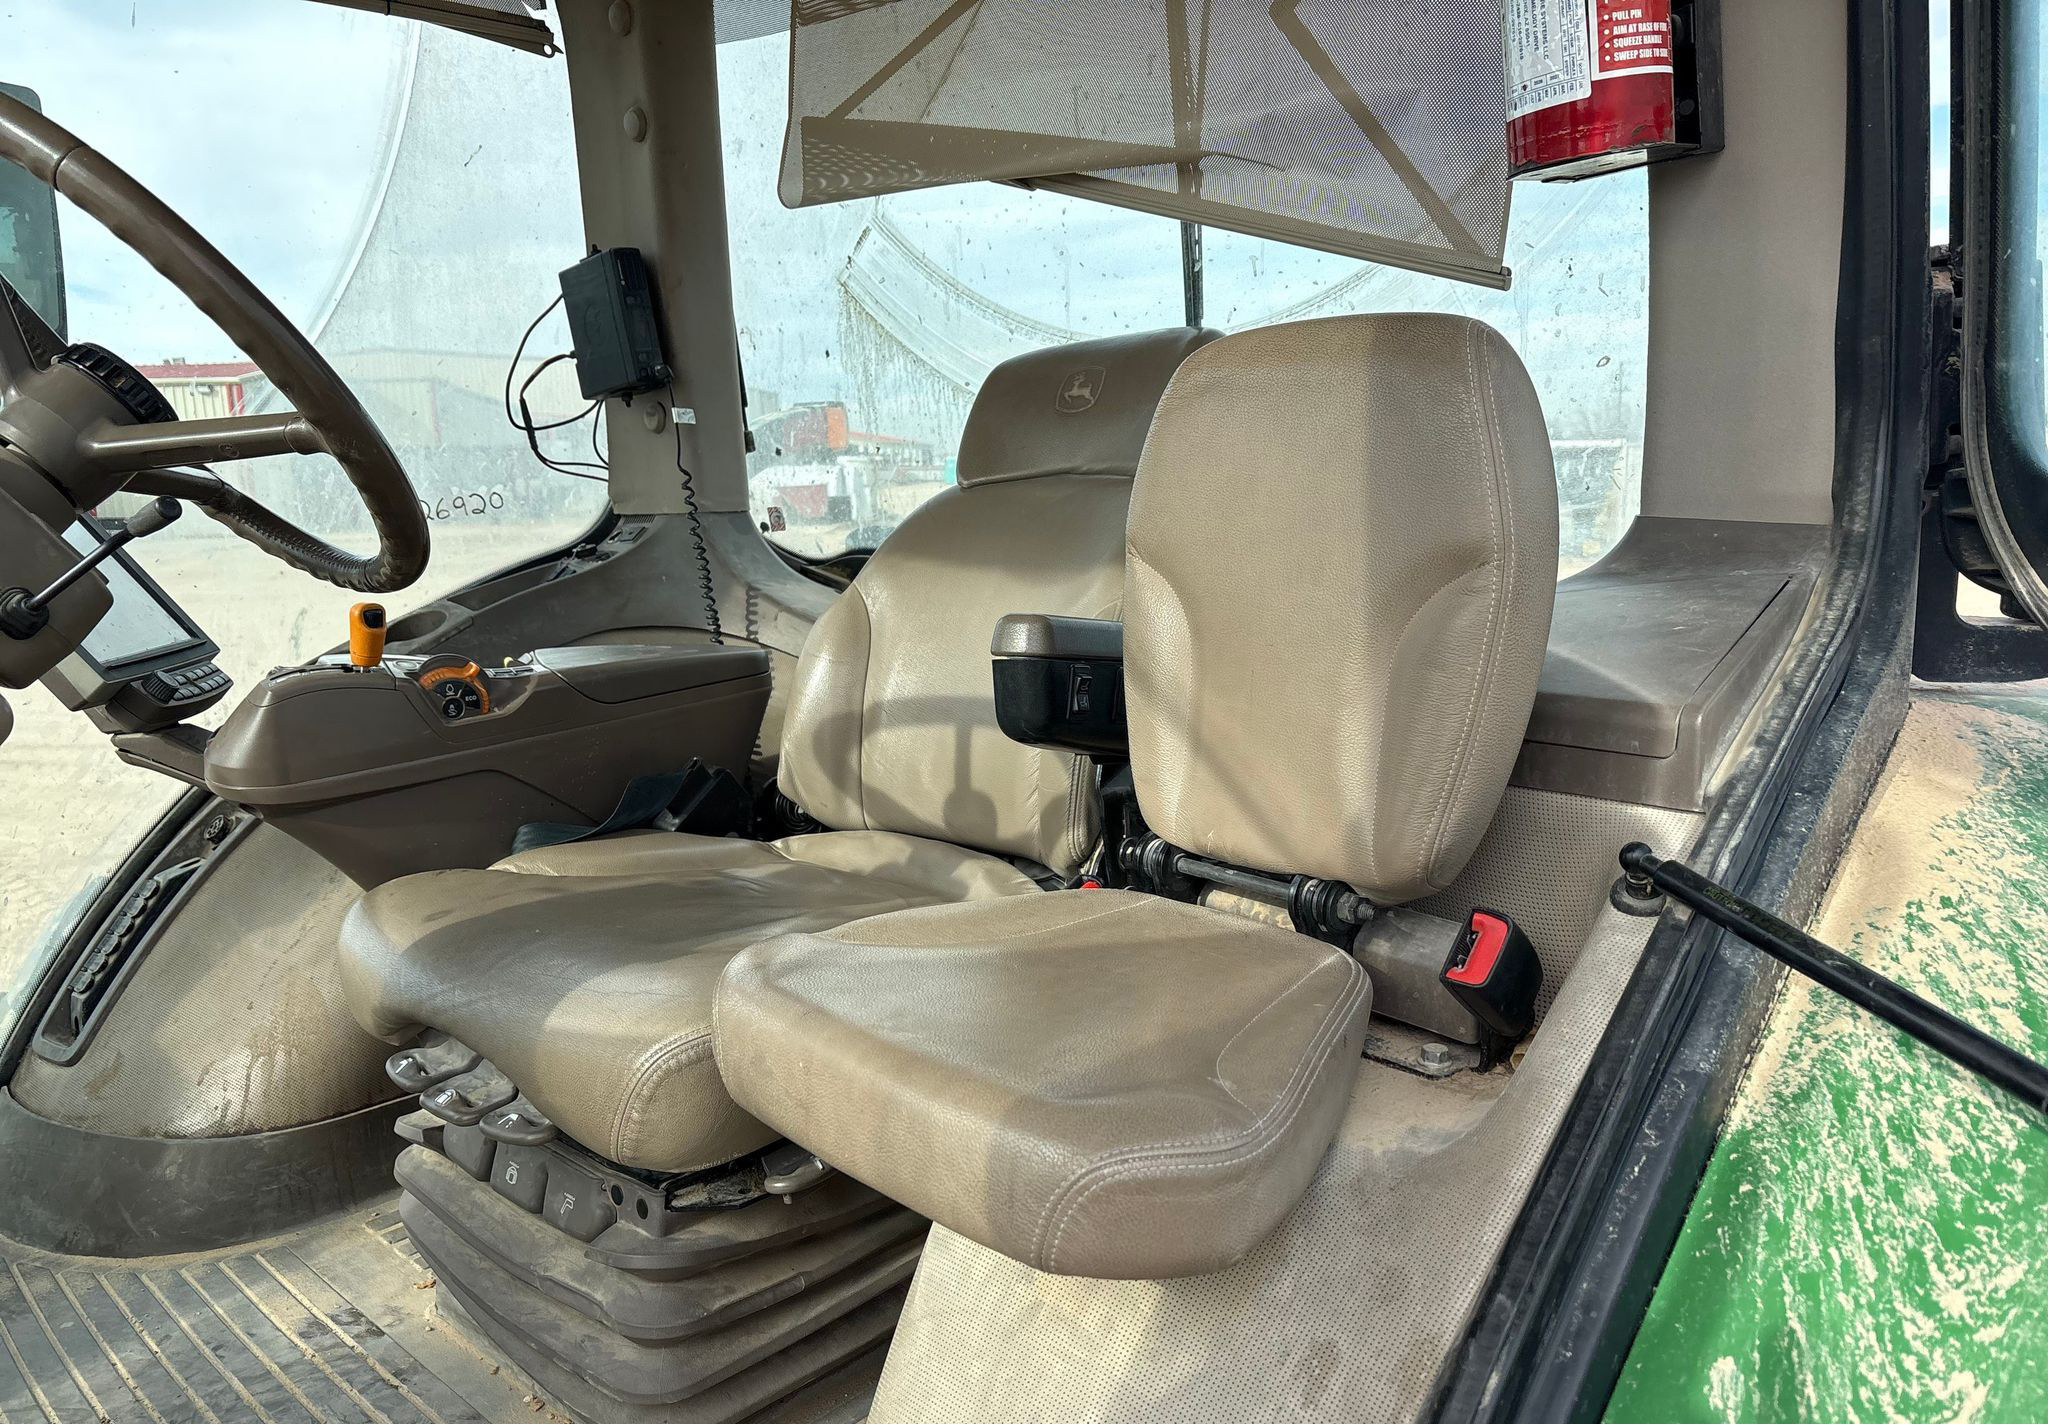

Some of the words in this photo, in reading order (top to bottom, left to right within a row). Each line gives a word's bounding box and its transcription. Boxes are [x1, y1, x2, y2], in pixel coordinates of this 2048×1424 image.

[1612, 10, 1629, 21] PULL
[1630, 9, 1642, 18] PIN
[1613, 25, 1628, 35] AIM
[1628, 23, 1637, 33] AT
[1638, 22, 1653, 32] BASE
[1613, 36, 1643, 48] SQUEEZE
[1643, 35, 1663, 44] HANDLE
[1614, 49, 1638, 61] SWEEP
[1639, 48, 1653, 58] SIDE
[1653, 48, 1660, 57] TO
[419, 491, 504, 520] 26920
